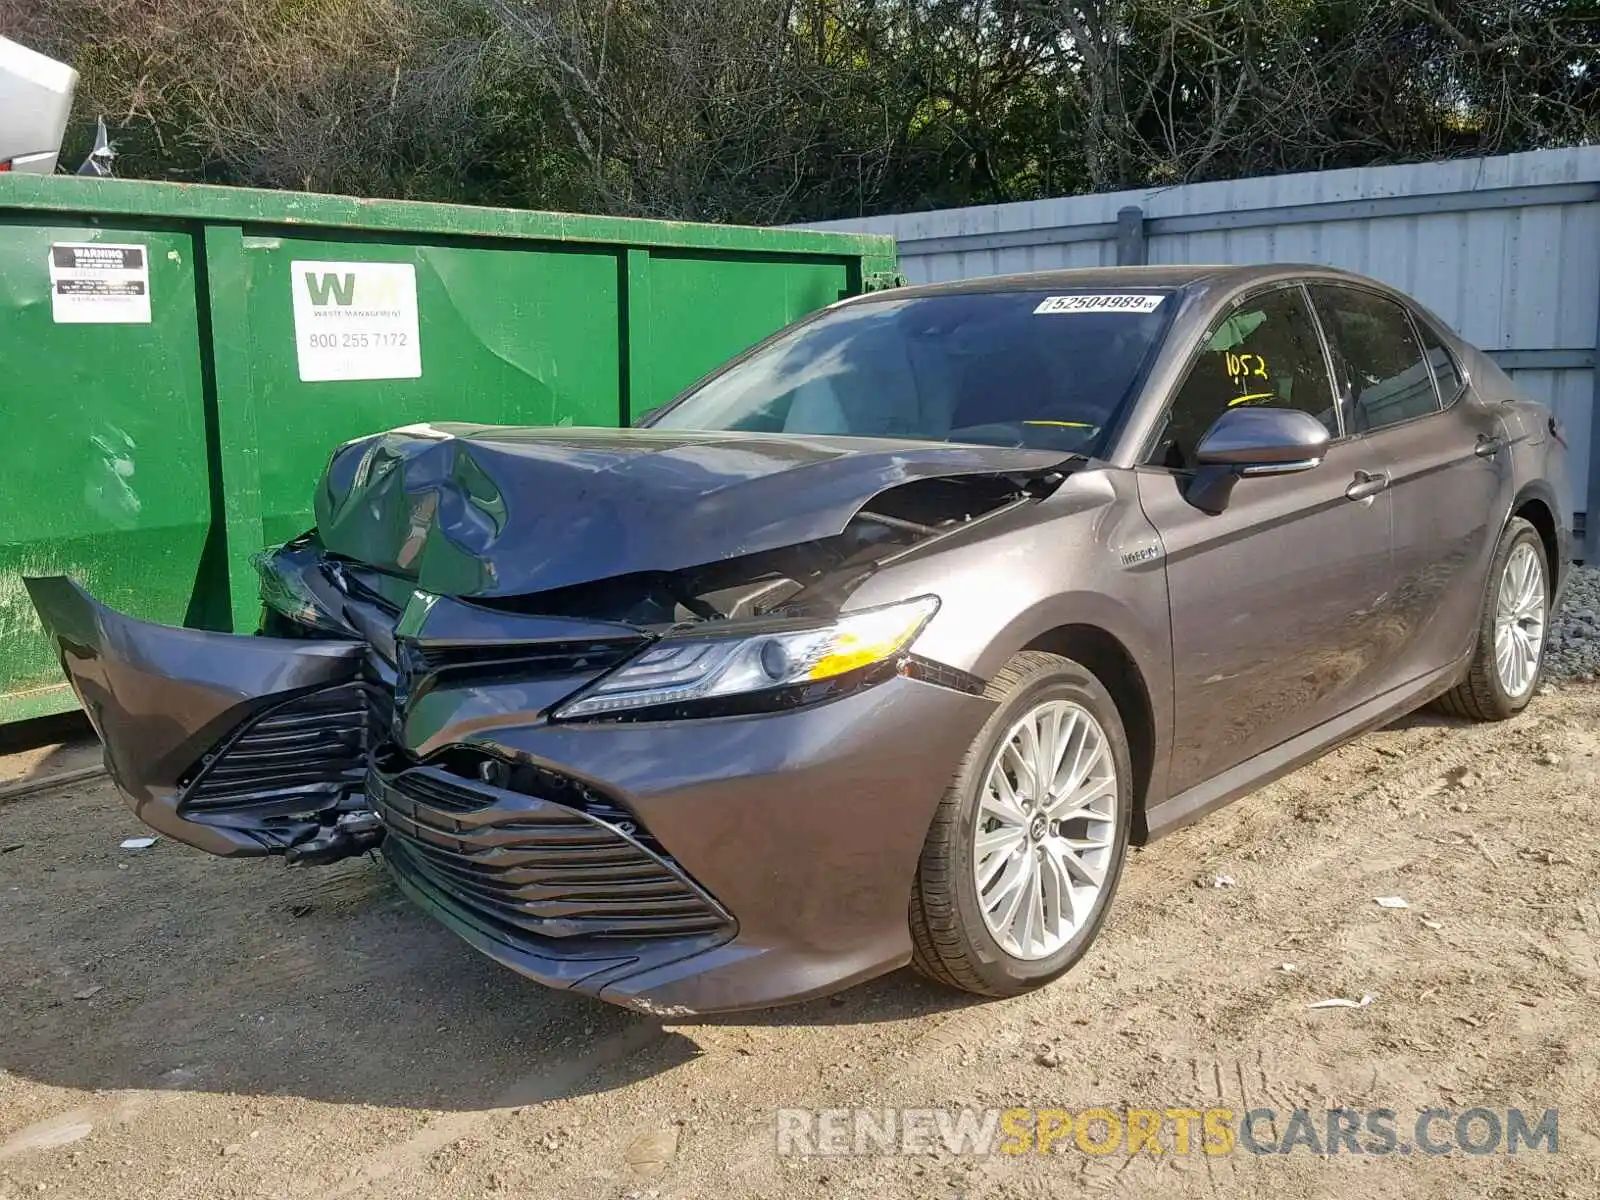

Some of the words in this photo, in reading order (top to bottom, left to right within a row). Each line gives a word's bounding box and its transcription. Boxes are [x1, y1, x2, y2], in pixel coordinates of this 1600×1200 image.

[73, 248, 124, 258] WARNING
[313, 310, 341, 318] WASTE
[344, 310, 401, 318] MANAGEMENT
[309, 333, 337, 348] 800
[342, 333, 369, 348] 255
[372, 332, 408, 347] 7172
[1225, 351, 1268, 380] 1052
